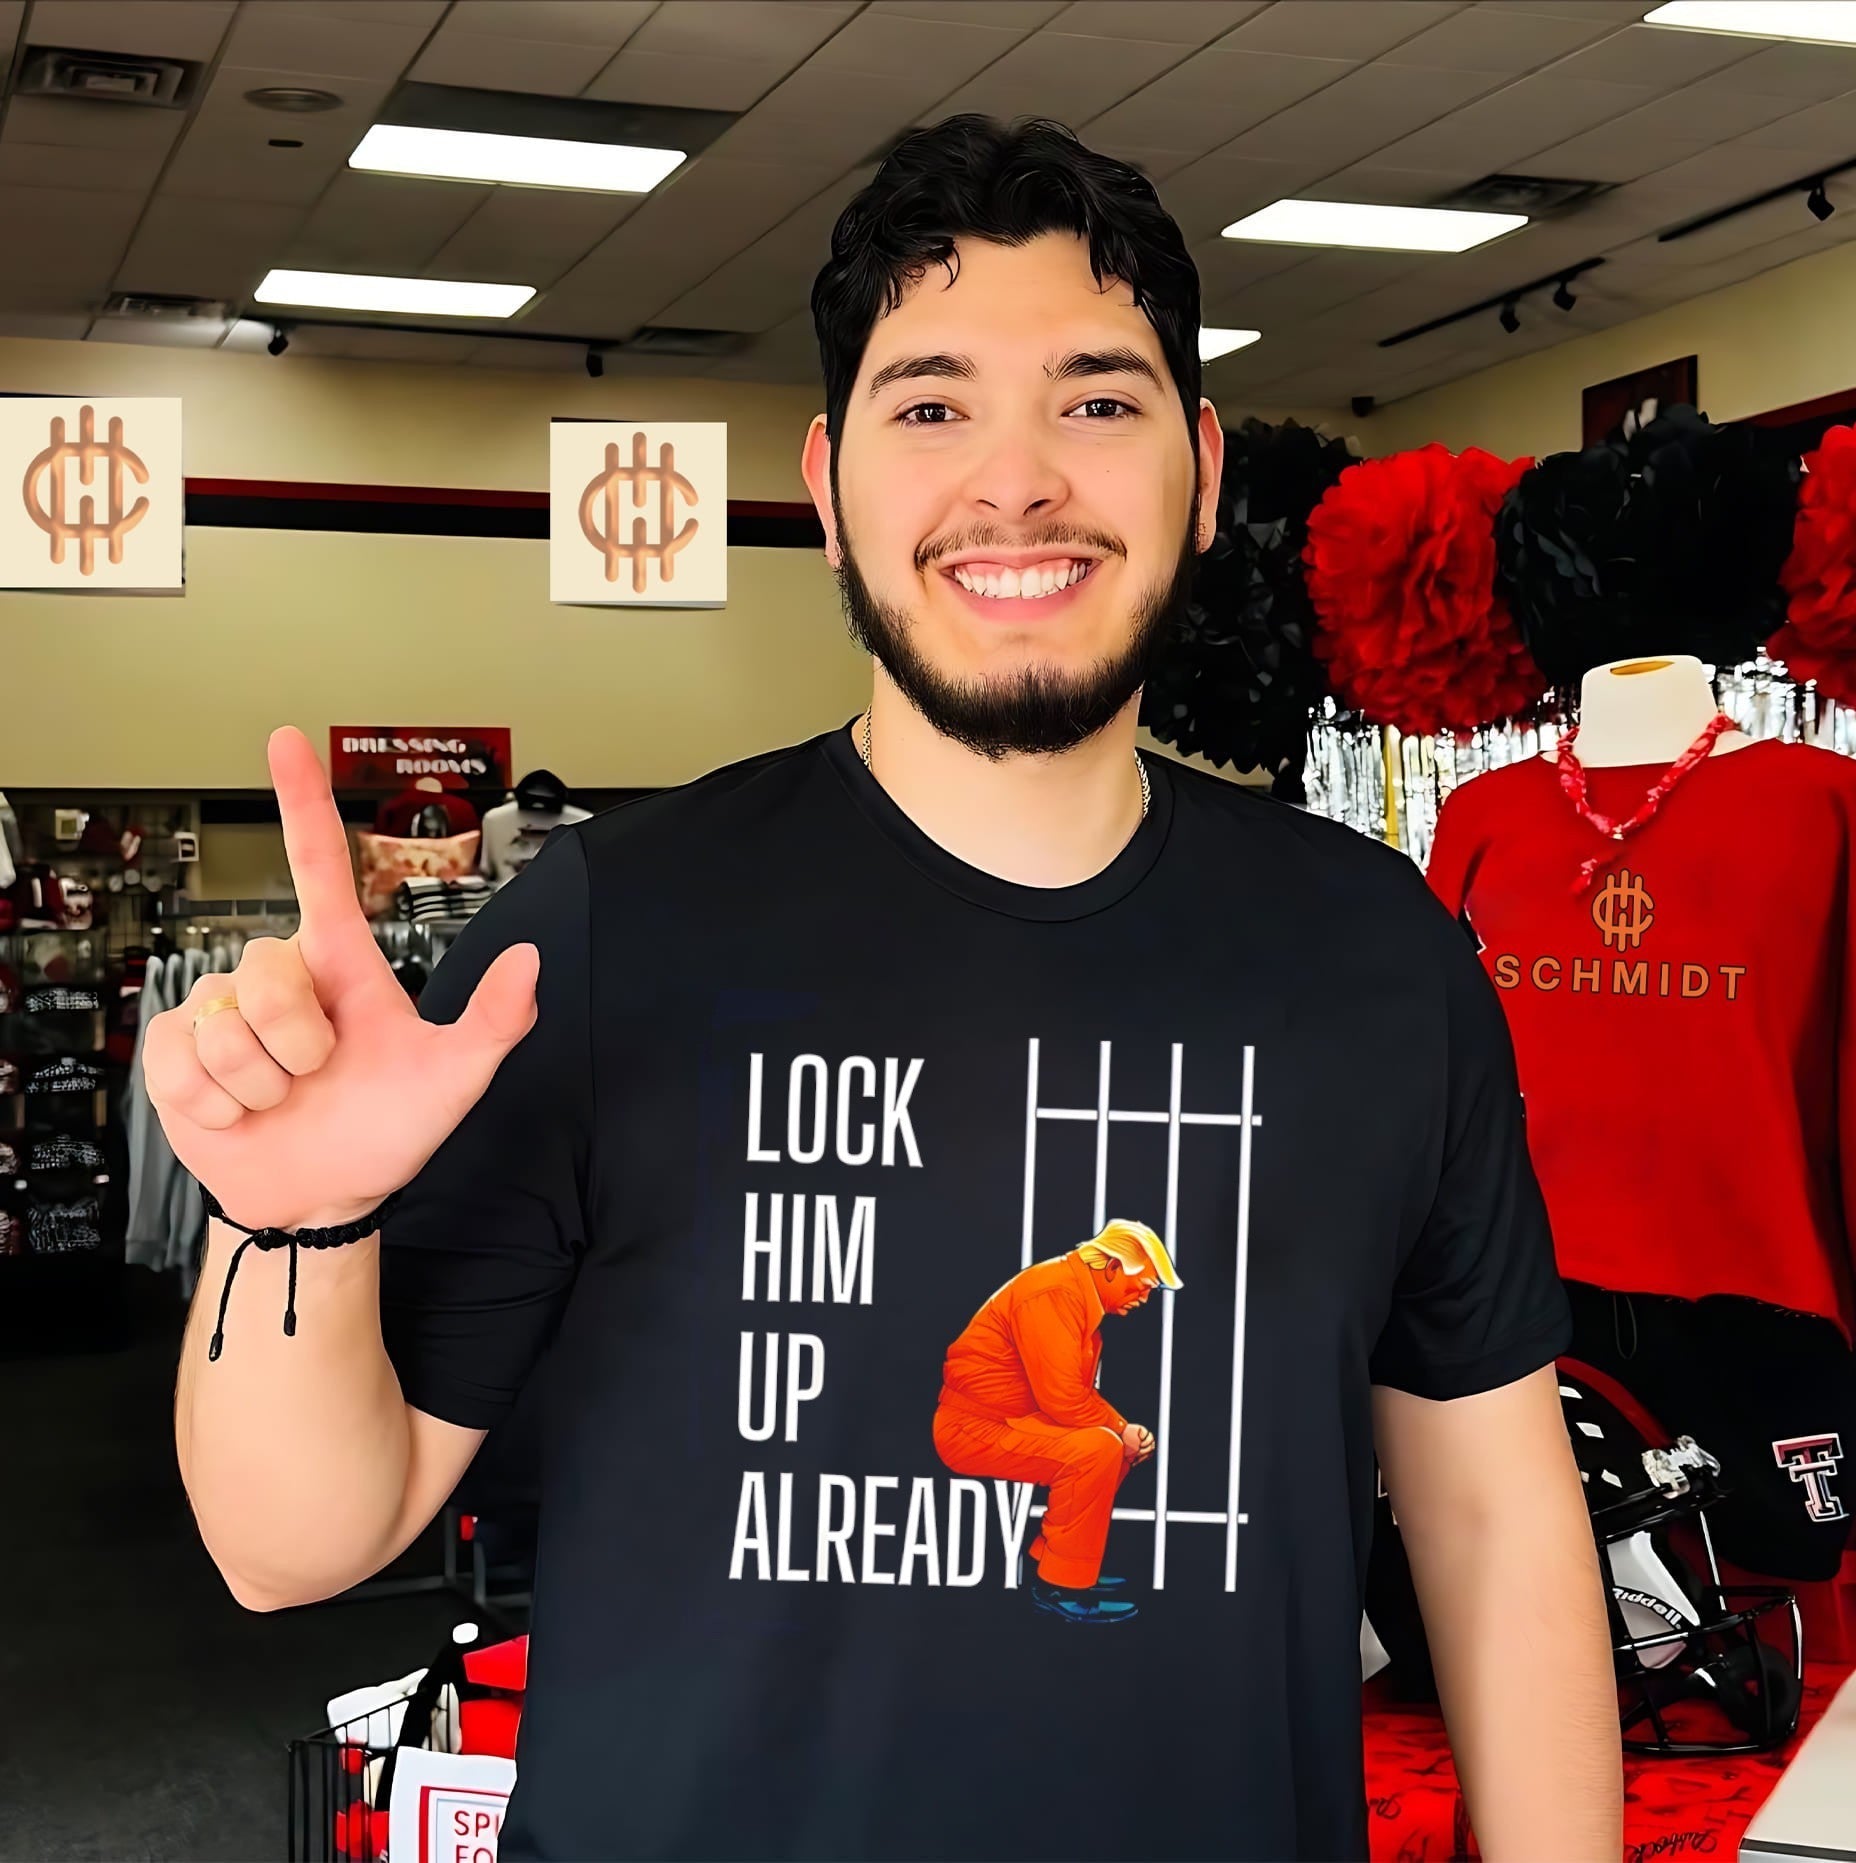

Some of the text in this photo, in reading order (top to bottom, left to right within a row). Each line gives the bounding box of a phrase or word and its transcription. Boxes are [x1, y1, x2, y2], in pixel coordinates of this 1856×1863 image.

[396, 758, 487, 775] ROOMS
[1494, 954, 1747, 1000] SCHMIDT
[746, 1052, 925, 1168] LOCK
[741, 1192, 877, 1305] HIM
[737, 1331, 825, 1442] UP
[728, 1471, 1034, 1590] ALREADY
